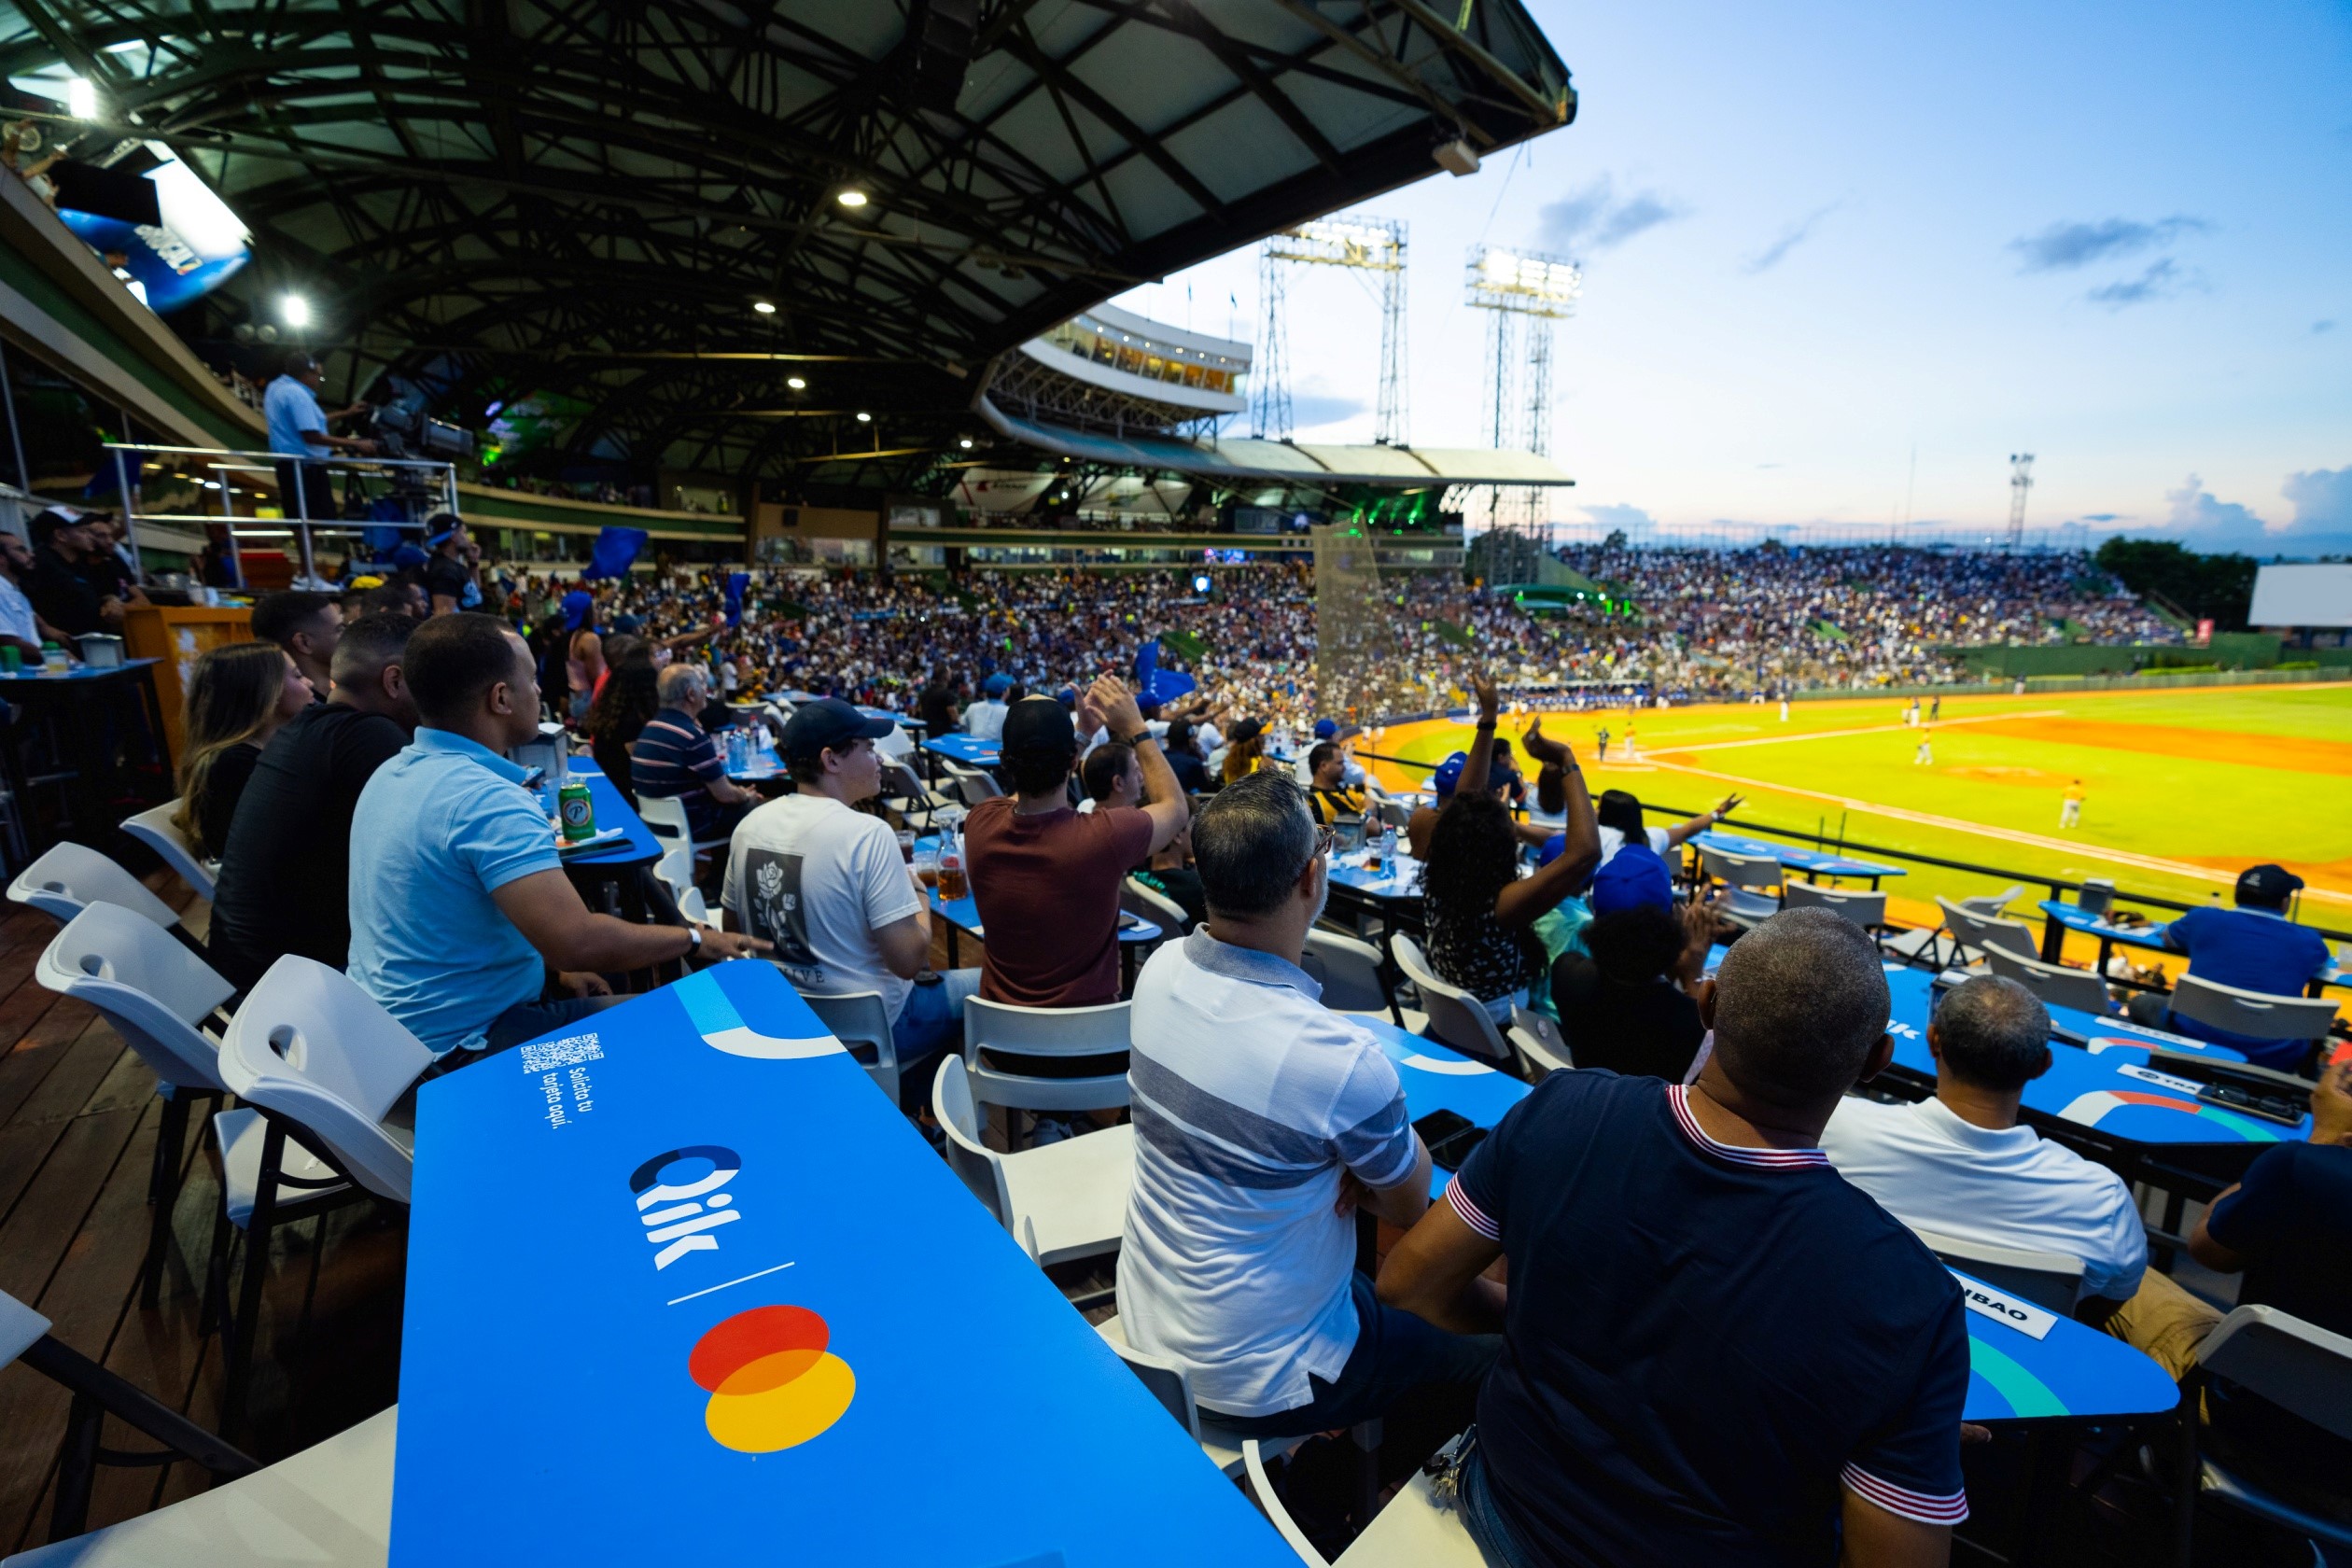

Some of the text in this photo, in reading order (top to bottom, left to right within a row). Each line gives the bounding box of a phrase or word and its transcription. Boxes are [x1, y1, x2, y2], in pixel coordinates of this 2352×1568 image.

[782, 968, 825, 983] IVE
[539, 1072, 573, 1130] tarjeta aquí.
[569, 1067, 595, 1113] Solicita tu
[1965, 1288, 2028, 1321] IBAO
